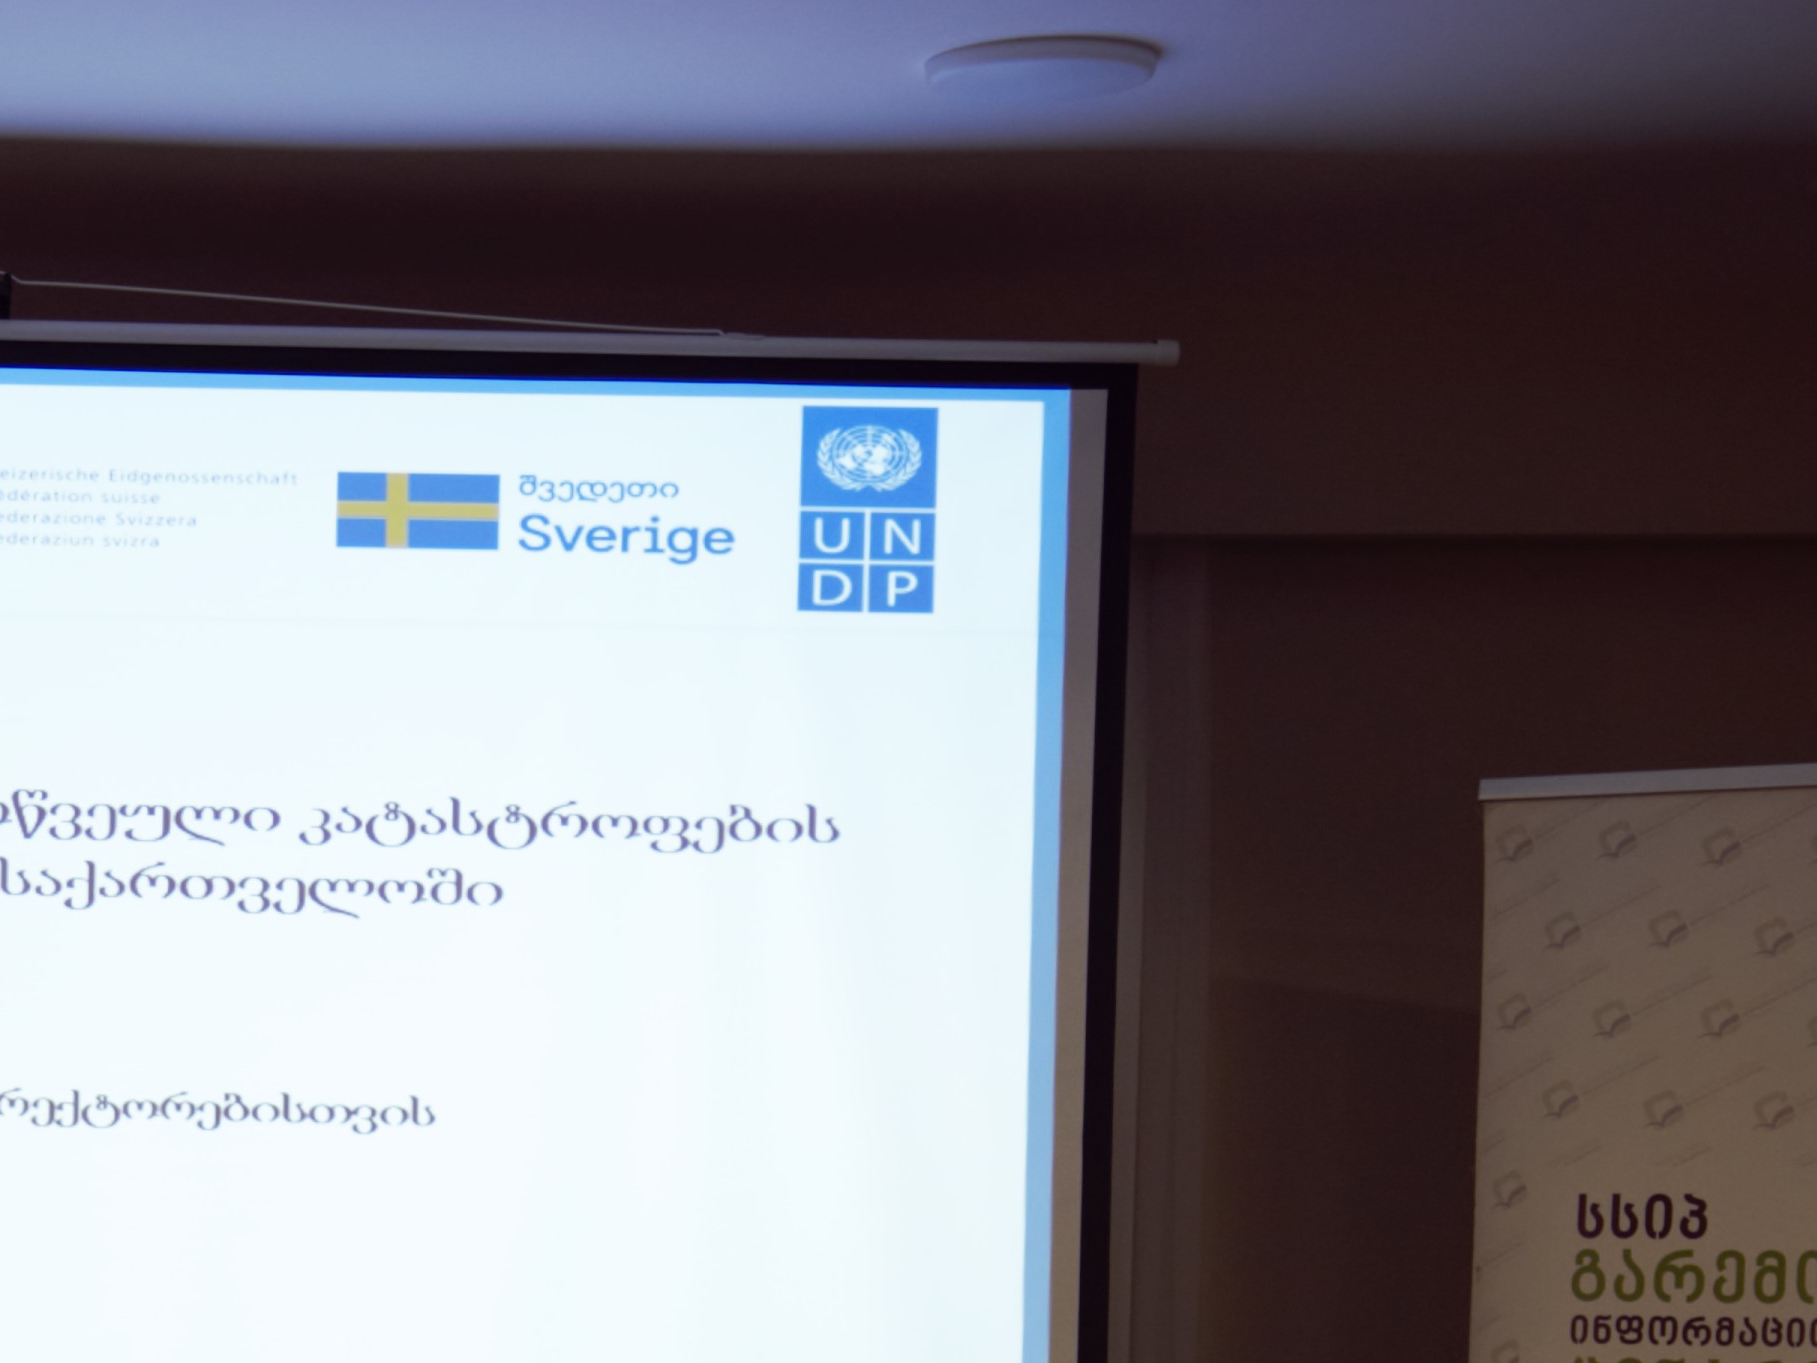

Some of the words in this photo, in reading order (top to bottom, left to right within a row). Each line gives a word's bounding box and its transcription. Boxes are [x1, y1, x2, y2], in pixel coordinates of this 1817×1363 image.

[108, 468, 297, 486] Eidgenossenschaft
[518, 474, 680, 504] შვედეთი
[101, 492, 161, 505] suisse
[115, 511, 197, 528] Svizzera
[102, 534, 161, 549] svizra
[518, 513, 736, 566] Sverige
[298, 796, 841, 854] კატასტროფების
[1577, 1192, 1708, 1240] სსიპ
